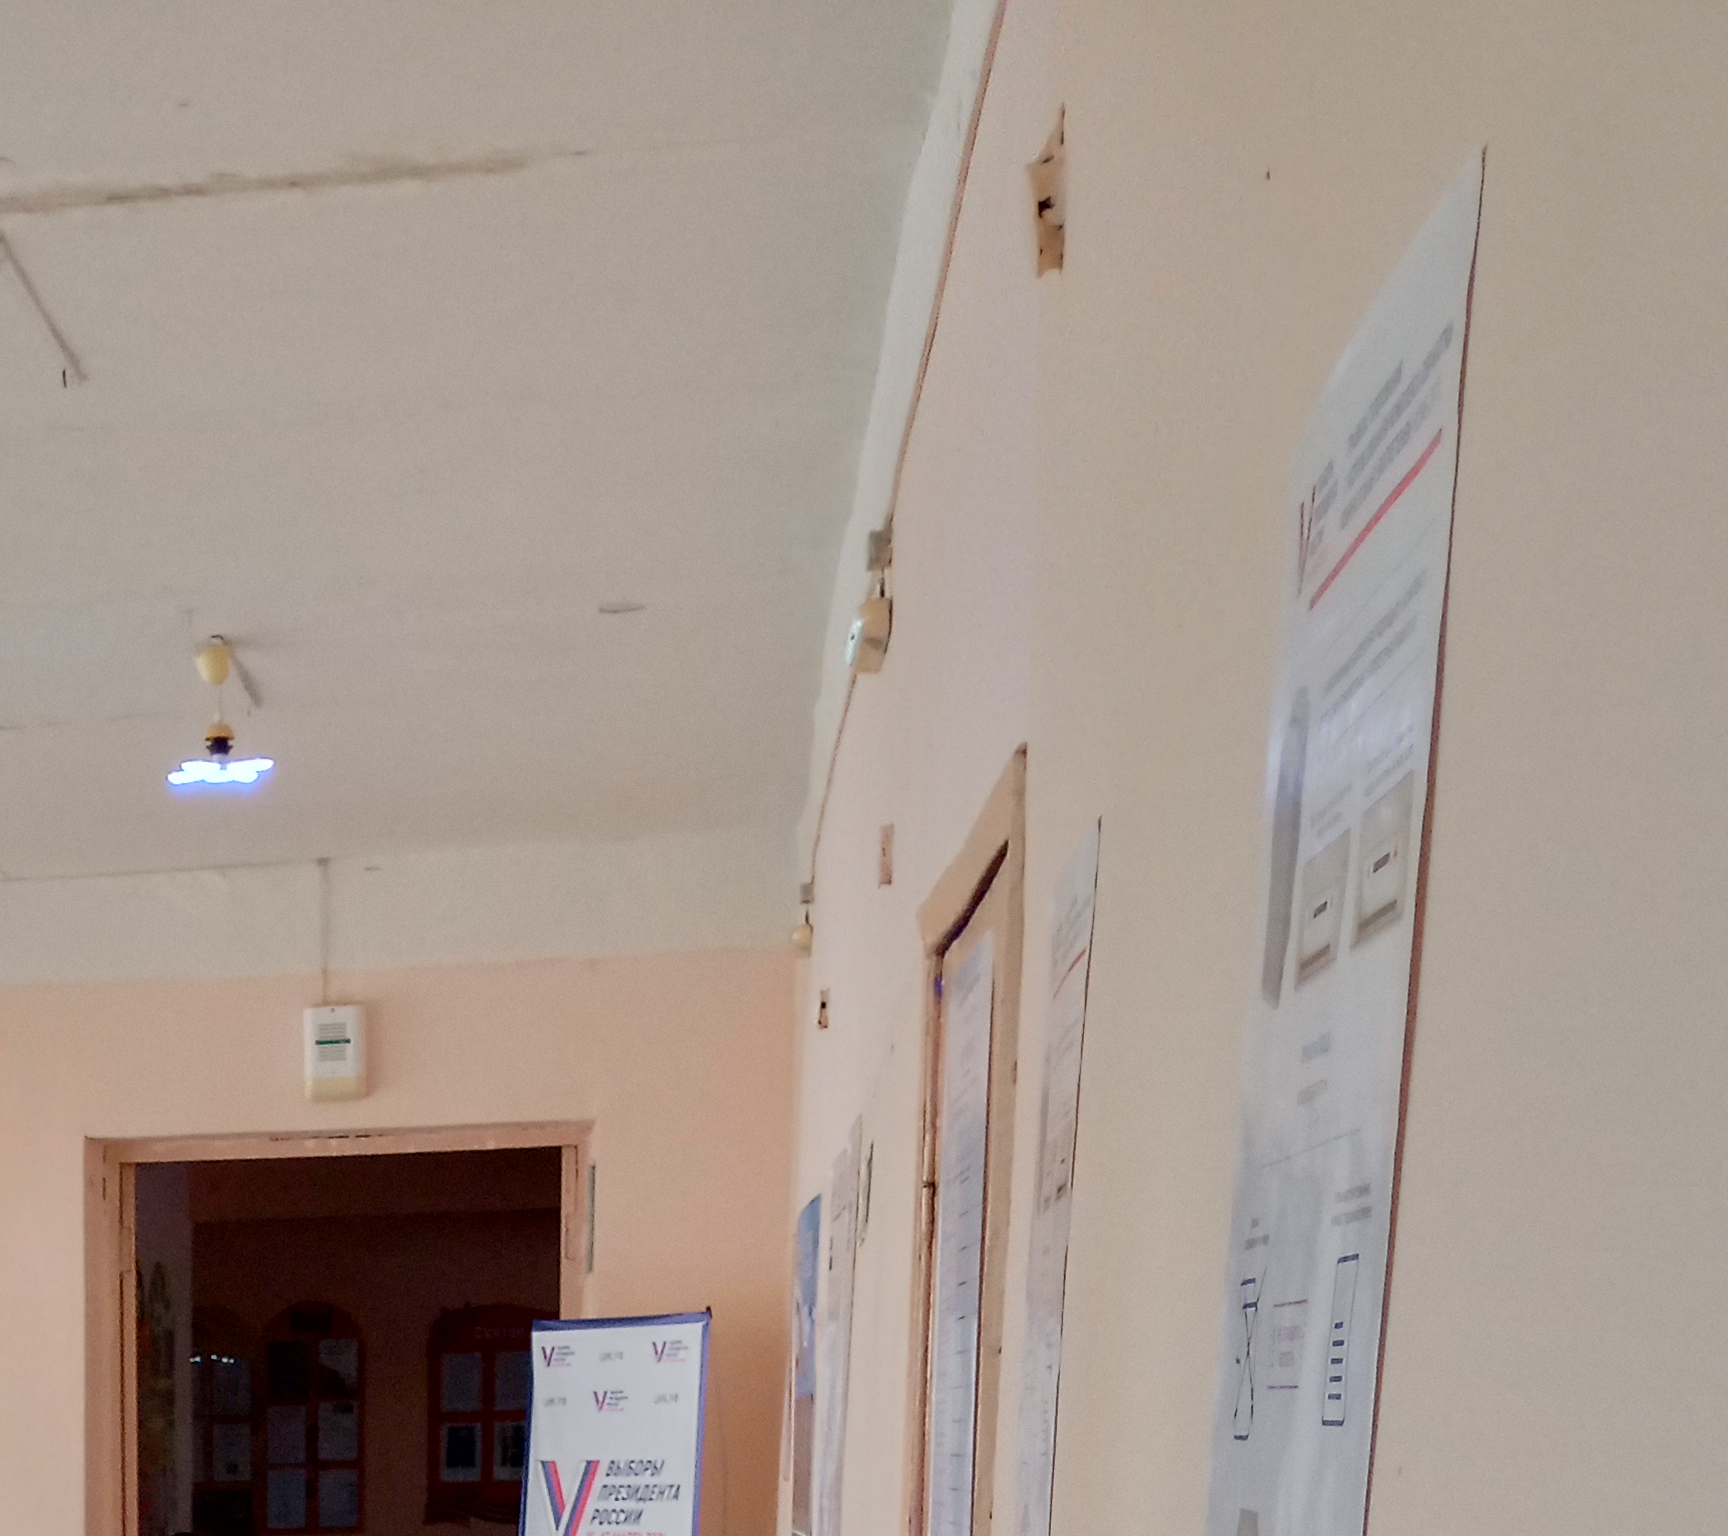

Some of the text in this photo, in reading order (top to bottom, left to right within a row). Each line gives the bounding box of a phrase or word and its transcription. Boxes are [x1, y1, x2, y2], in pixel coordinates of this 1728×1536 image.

[605, 1459, 665, 1477] ВЫБОРЫ
[597, 1484, 681, 1503] ПРЕЗИДЕНТА
[591, 1508, 644, 1526] РОССИИ
